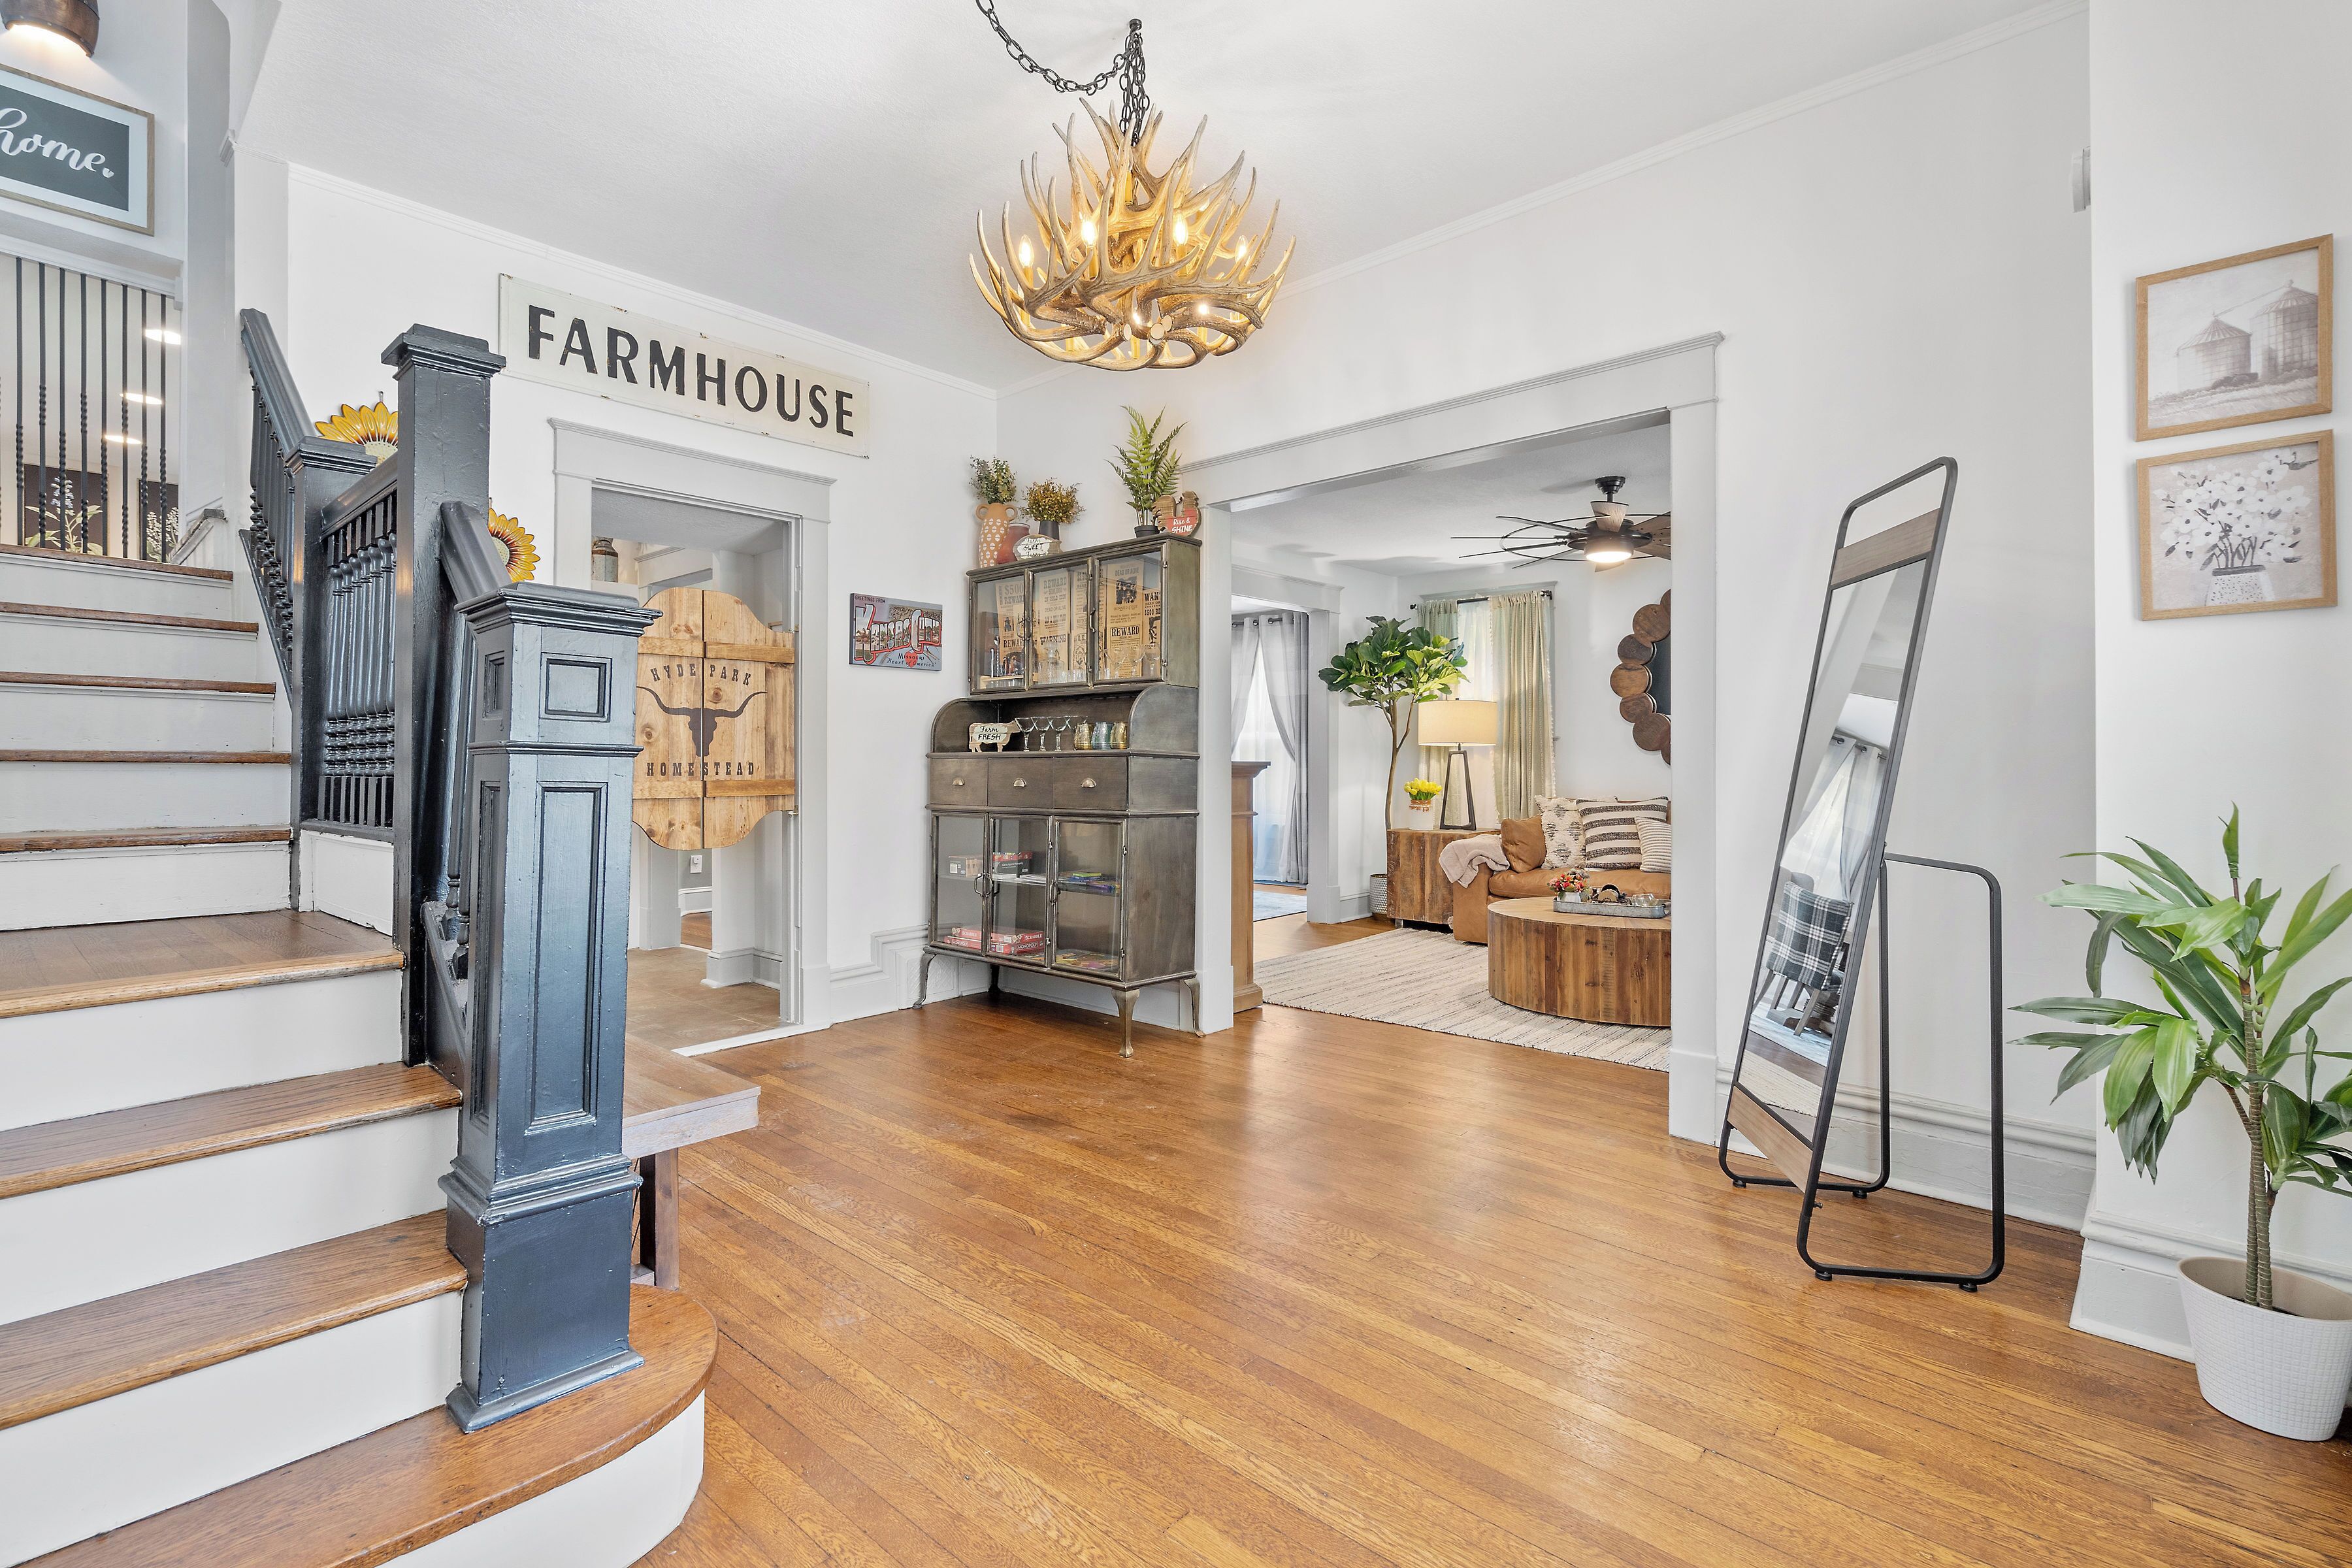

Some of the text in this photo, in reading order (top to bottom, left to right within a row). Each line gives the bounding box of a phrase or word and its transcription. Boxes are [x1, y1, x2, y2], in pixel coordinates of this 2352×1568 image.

[528, 304, 853, 437] FARMHOUSE
[1171, 525, 1193, 534] SHINE
[1043, 577, 1067, 589] REWARD
[1004, 595, 1024, 605] REWAR
[854, 604, 941, 665] KANSAS CITY
[1111, 625, 1139, 636] REWARD
[1040, 634, 1066, 645] WARNING
[650, 663, 751, 685] HYDE PARK
[647, 762, 754, 776] HOMESTEAD
